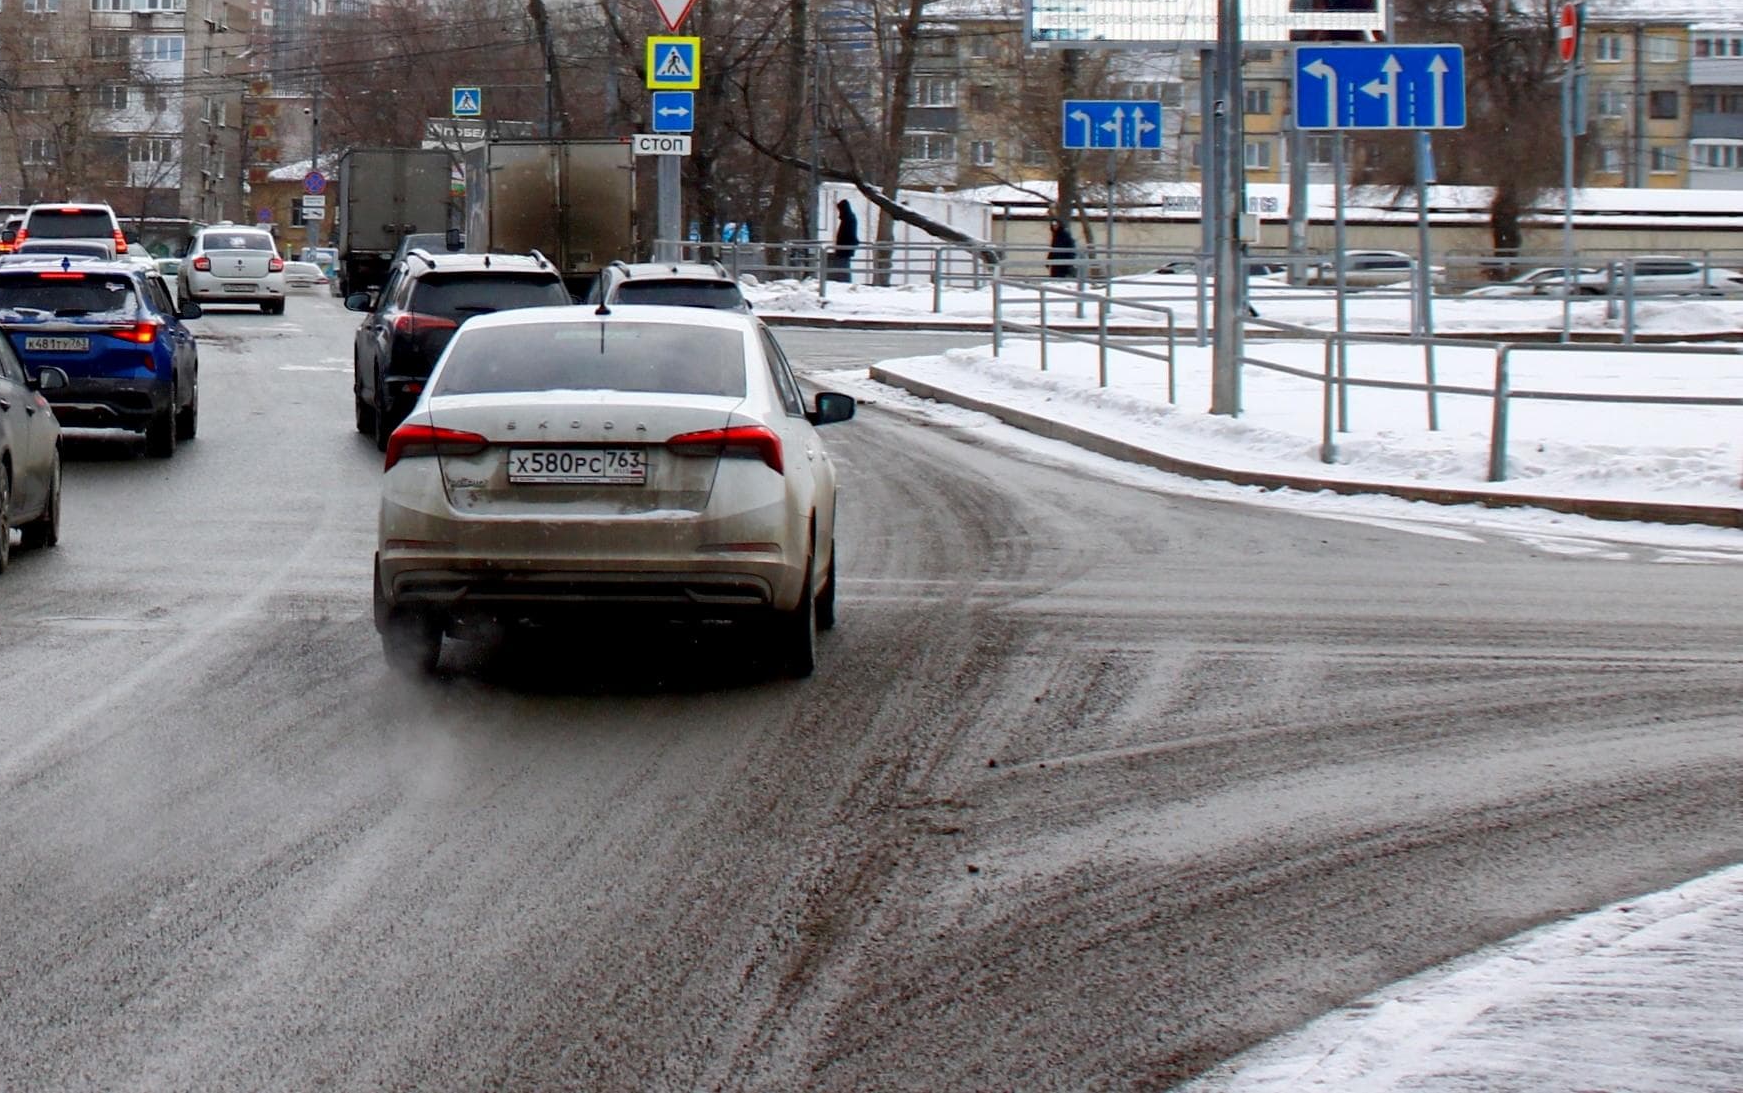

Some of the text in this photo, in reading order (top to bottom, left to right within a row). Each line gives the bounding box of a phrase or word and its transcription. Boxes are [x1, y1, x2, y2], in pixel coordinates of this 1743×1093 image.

[640, 138, 684, 151] СТОП
[27, 338, 68, 348] К481ТУ
[515, 451, 641, 474] Х580РС 763
